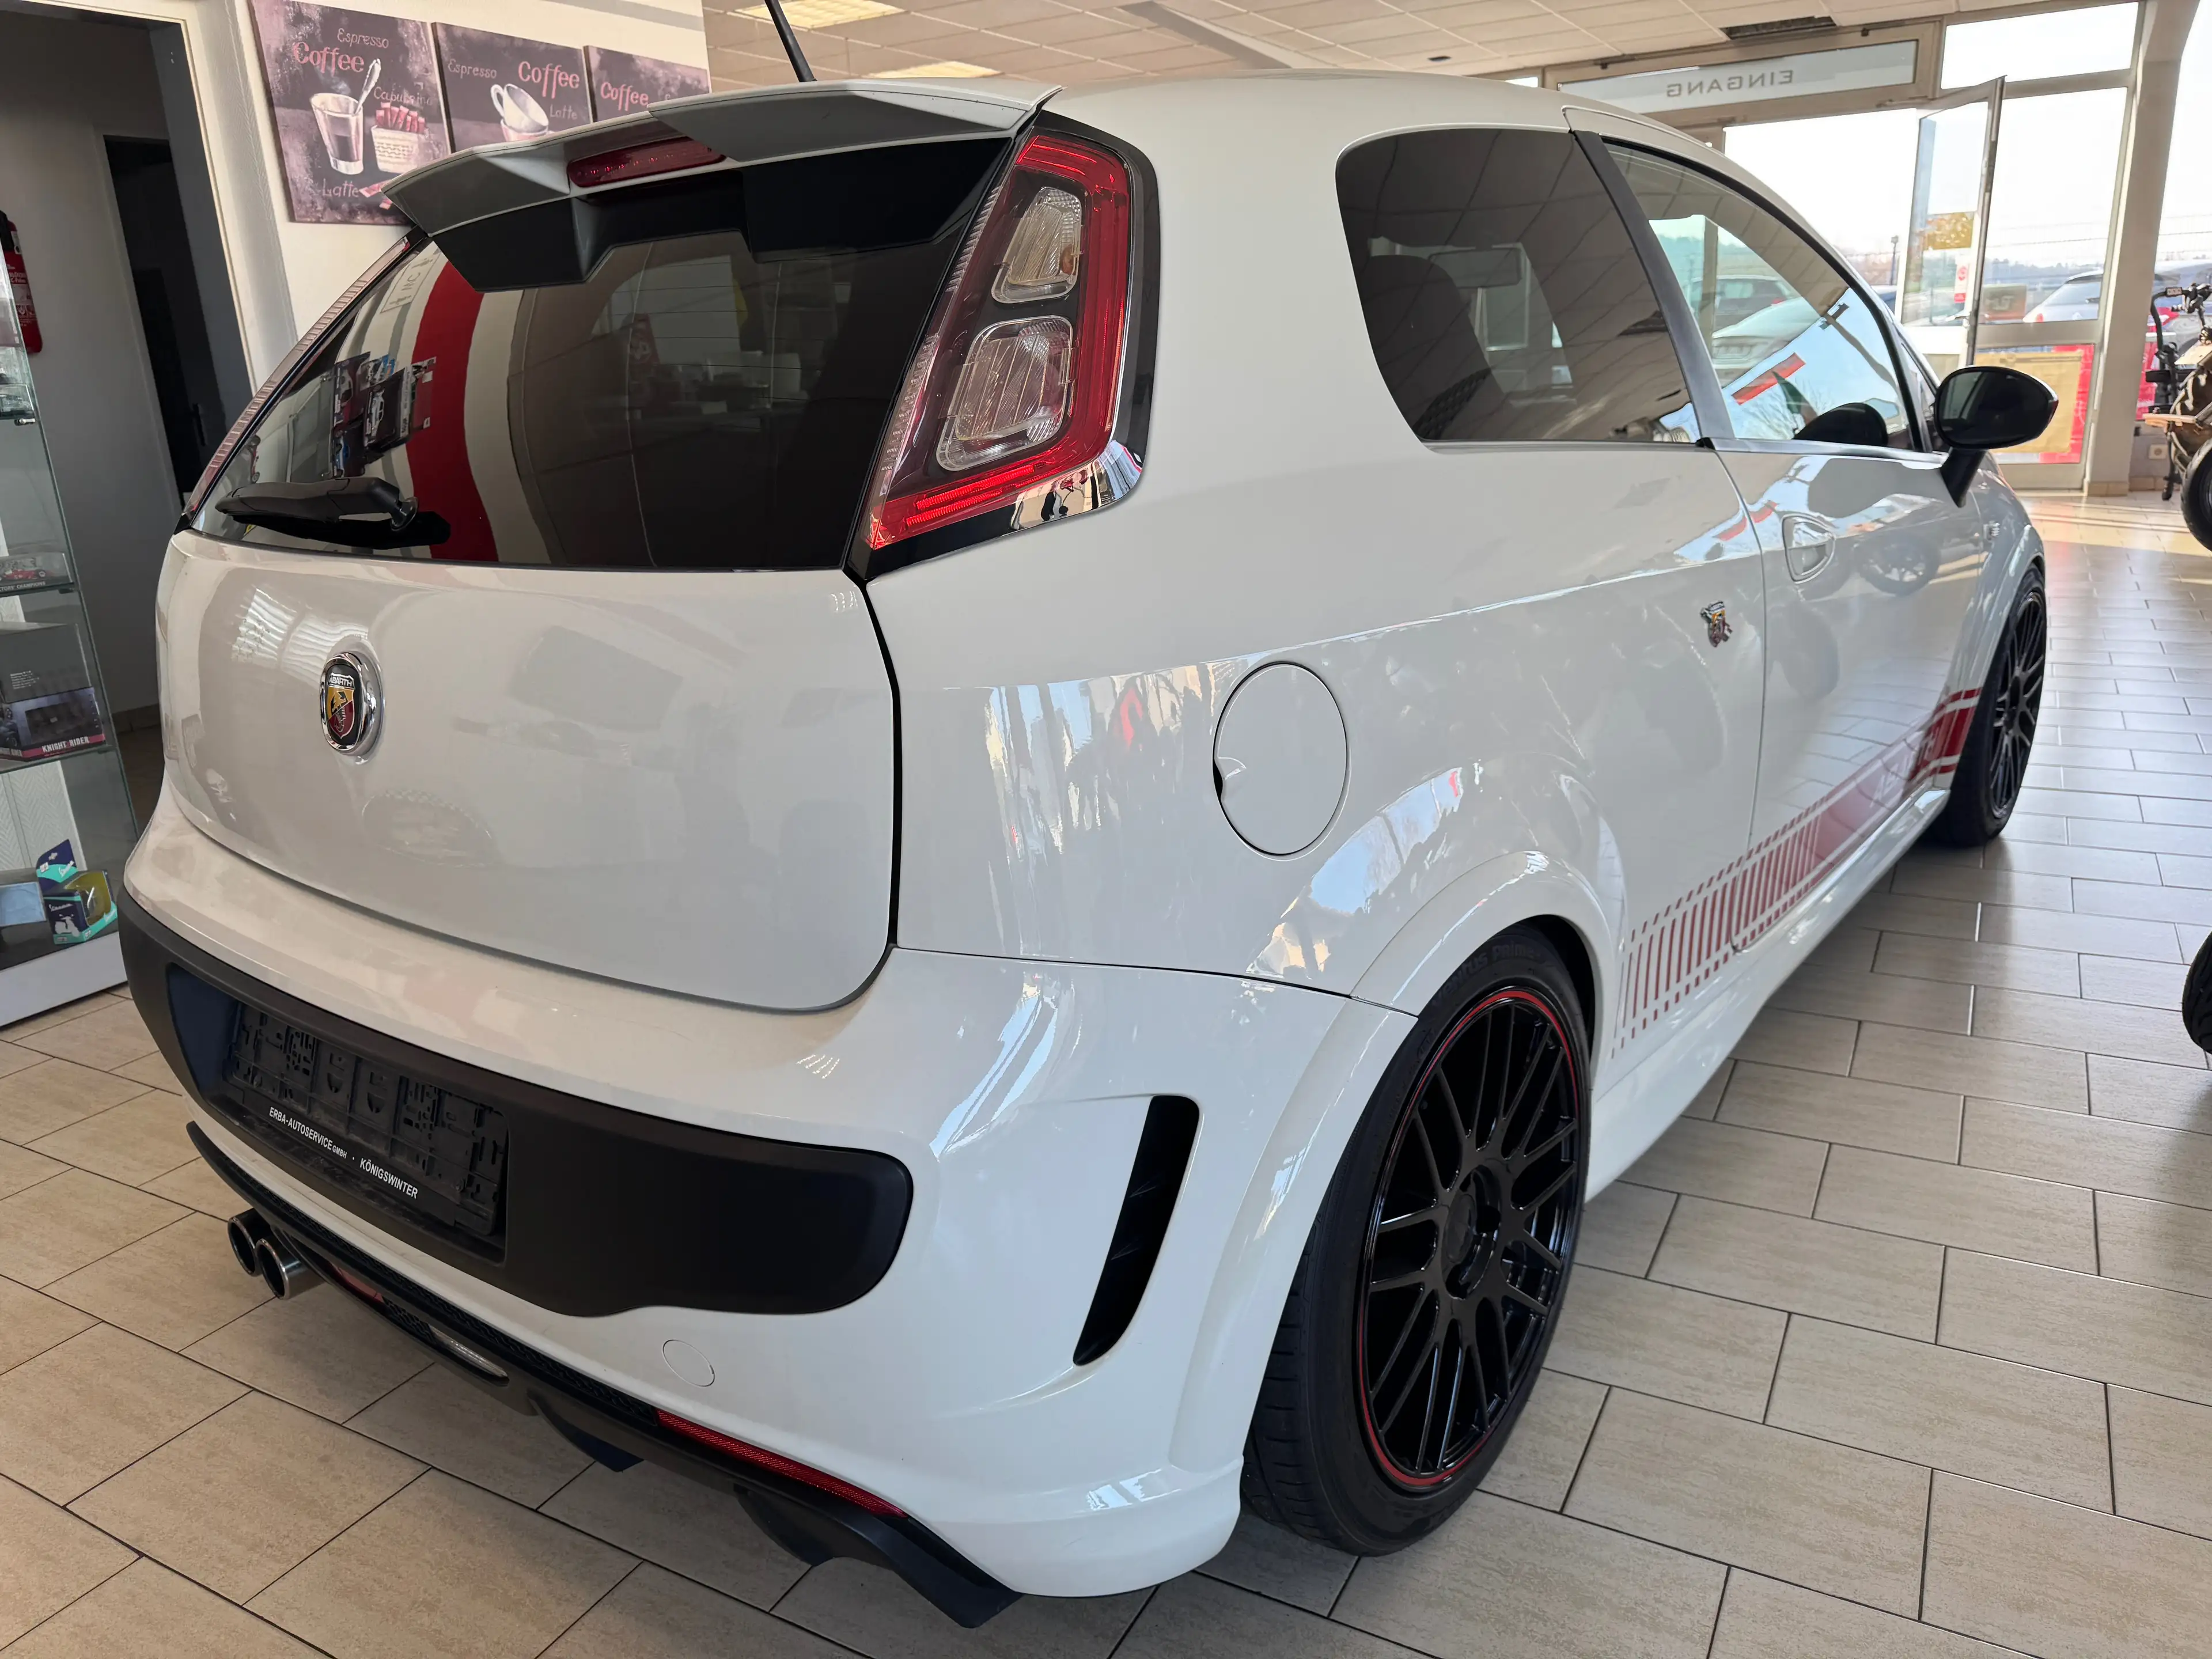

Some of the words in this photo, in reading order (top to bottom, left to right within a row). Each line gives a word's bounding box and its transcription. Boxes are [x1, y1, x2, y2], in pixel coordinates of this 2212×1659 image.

[337, 28, 389, 48] Espresso
[292, 41, 365, 75] Coffee
[447, 58, 497, 79] Espresso
[518, 60, 580, 100] Coffee
[600, 81, 649, 112] Coffee
[550, 104, 578, 120] Latte
[322, 178, 360, 198] Latte
[329, 676, 353, 687] ABARTH
[41, 741, 67, 753] KNIGHT
[69, 736, 89, 747] RIDER
[359, 1158, 418, 1199] KÖNIGSWINTER
